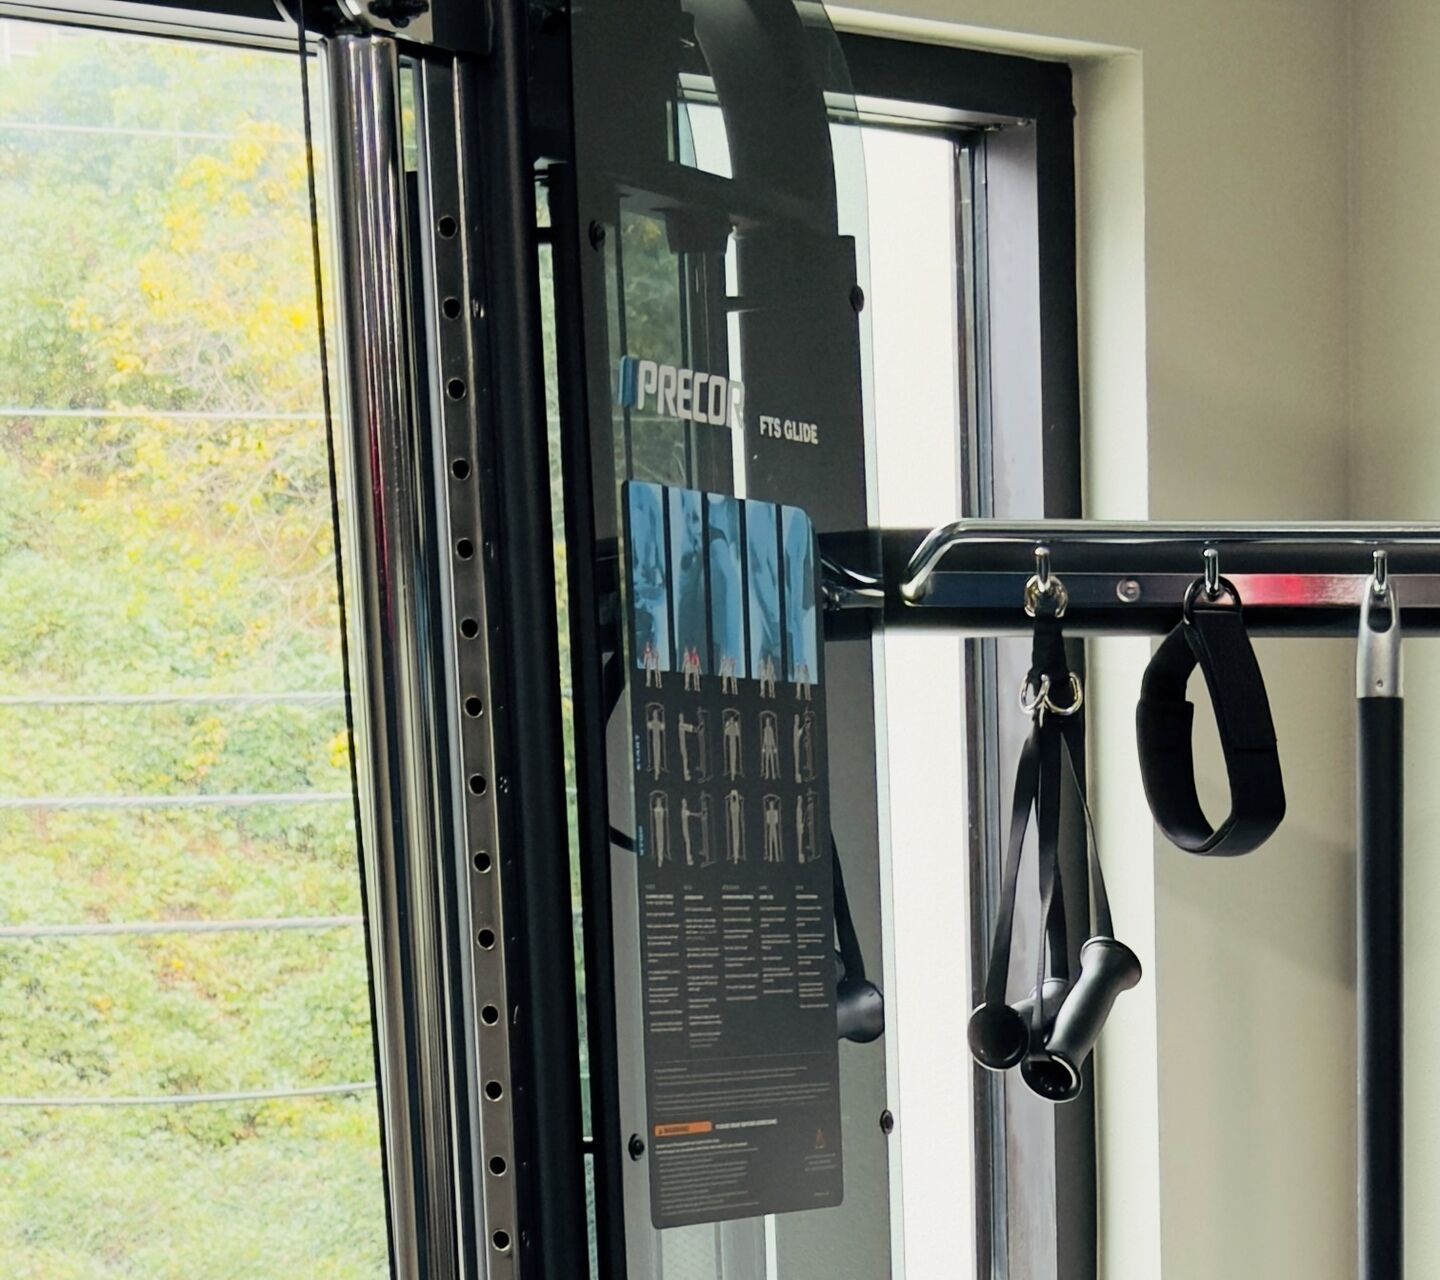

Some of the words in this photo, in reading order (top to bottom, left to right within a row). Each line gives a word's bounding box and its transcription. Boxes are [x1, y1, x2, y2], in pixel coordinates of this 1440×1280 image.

[637, 359, 745, 430] PRECOR
[759, 414, 782, 439] FTS
[784, 419, 819, 445] GLIDE
